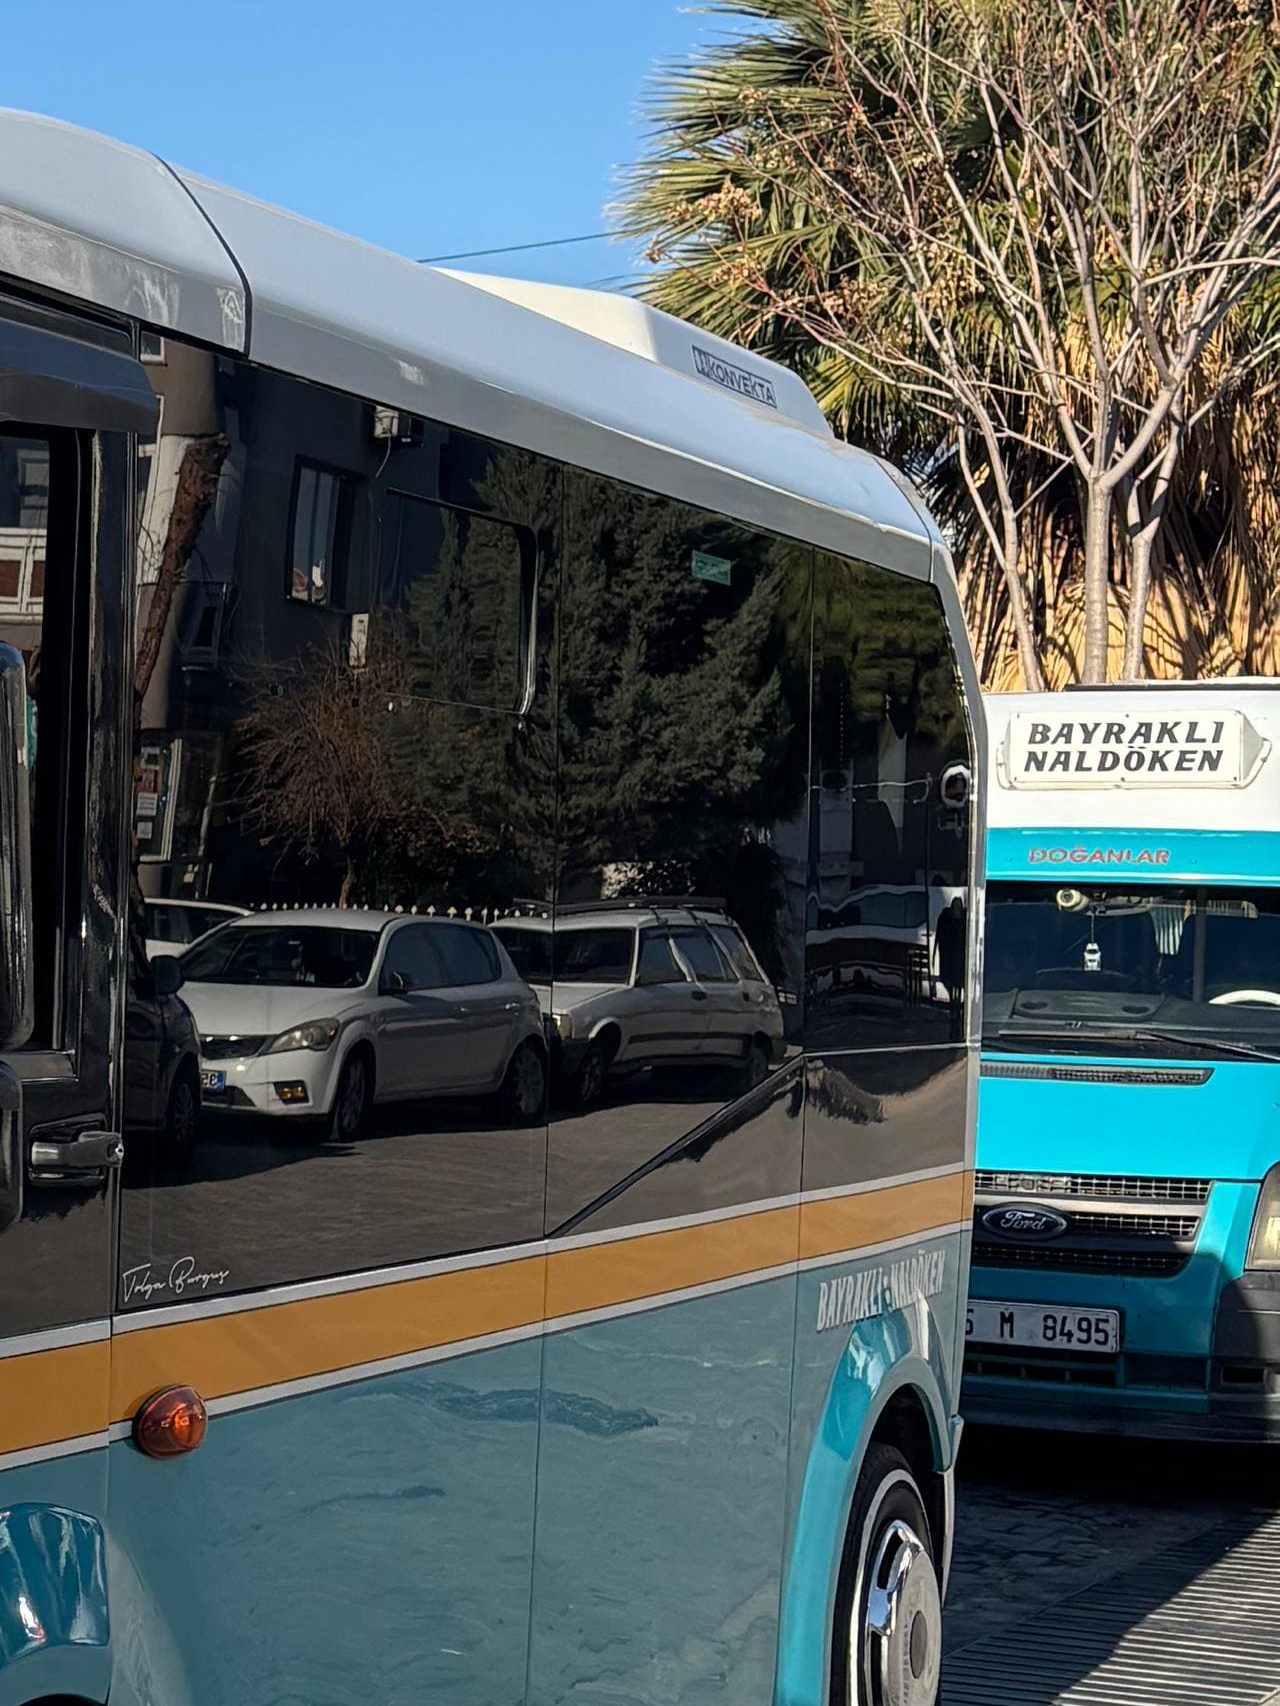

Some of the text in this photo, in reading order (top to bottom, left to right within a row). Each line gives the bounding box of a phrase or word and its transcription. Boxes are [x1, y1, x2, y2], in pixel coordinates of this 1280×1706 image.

[708, 359, 774, 403] KONVEKTA
[1028, 721, 1224, 745] BAYRAKLI
[1024, 746, 1223, 772] NALDÖKEN
[1028, 846, 1170, 864] DOĞANLAR
[1000, 1210, 1046, 1231] Ford
[817, 1266, 885, 1334] BAYRAKLI
[999, 1311, 1015, 1339] M
[1042, 1314, 1110, 1345] 8495
